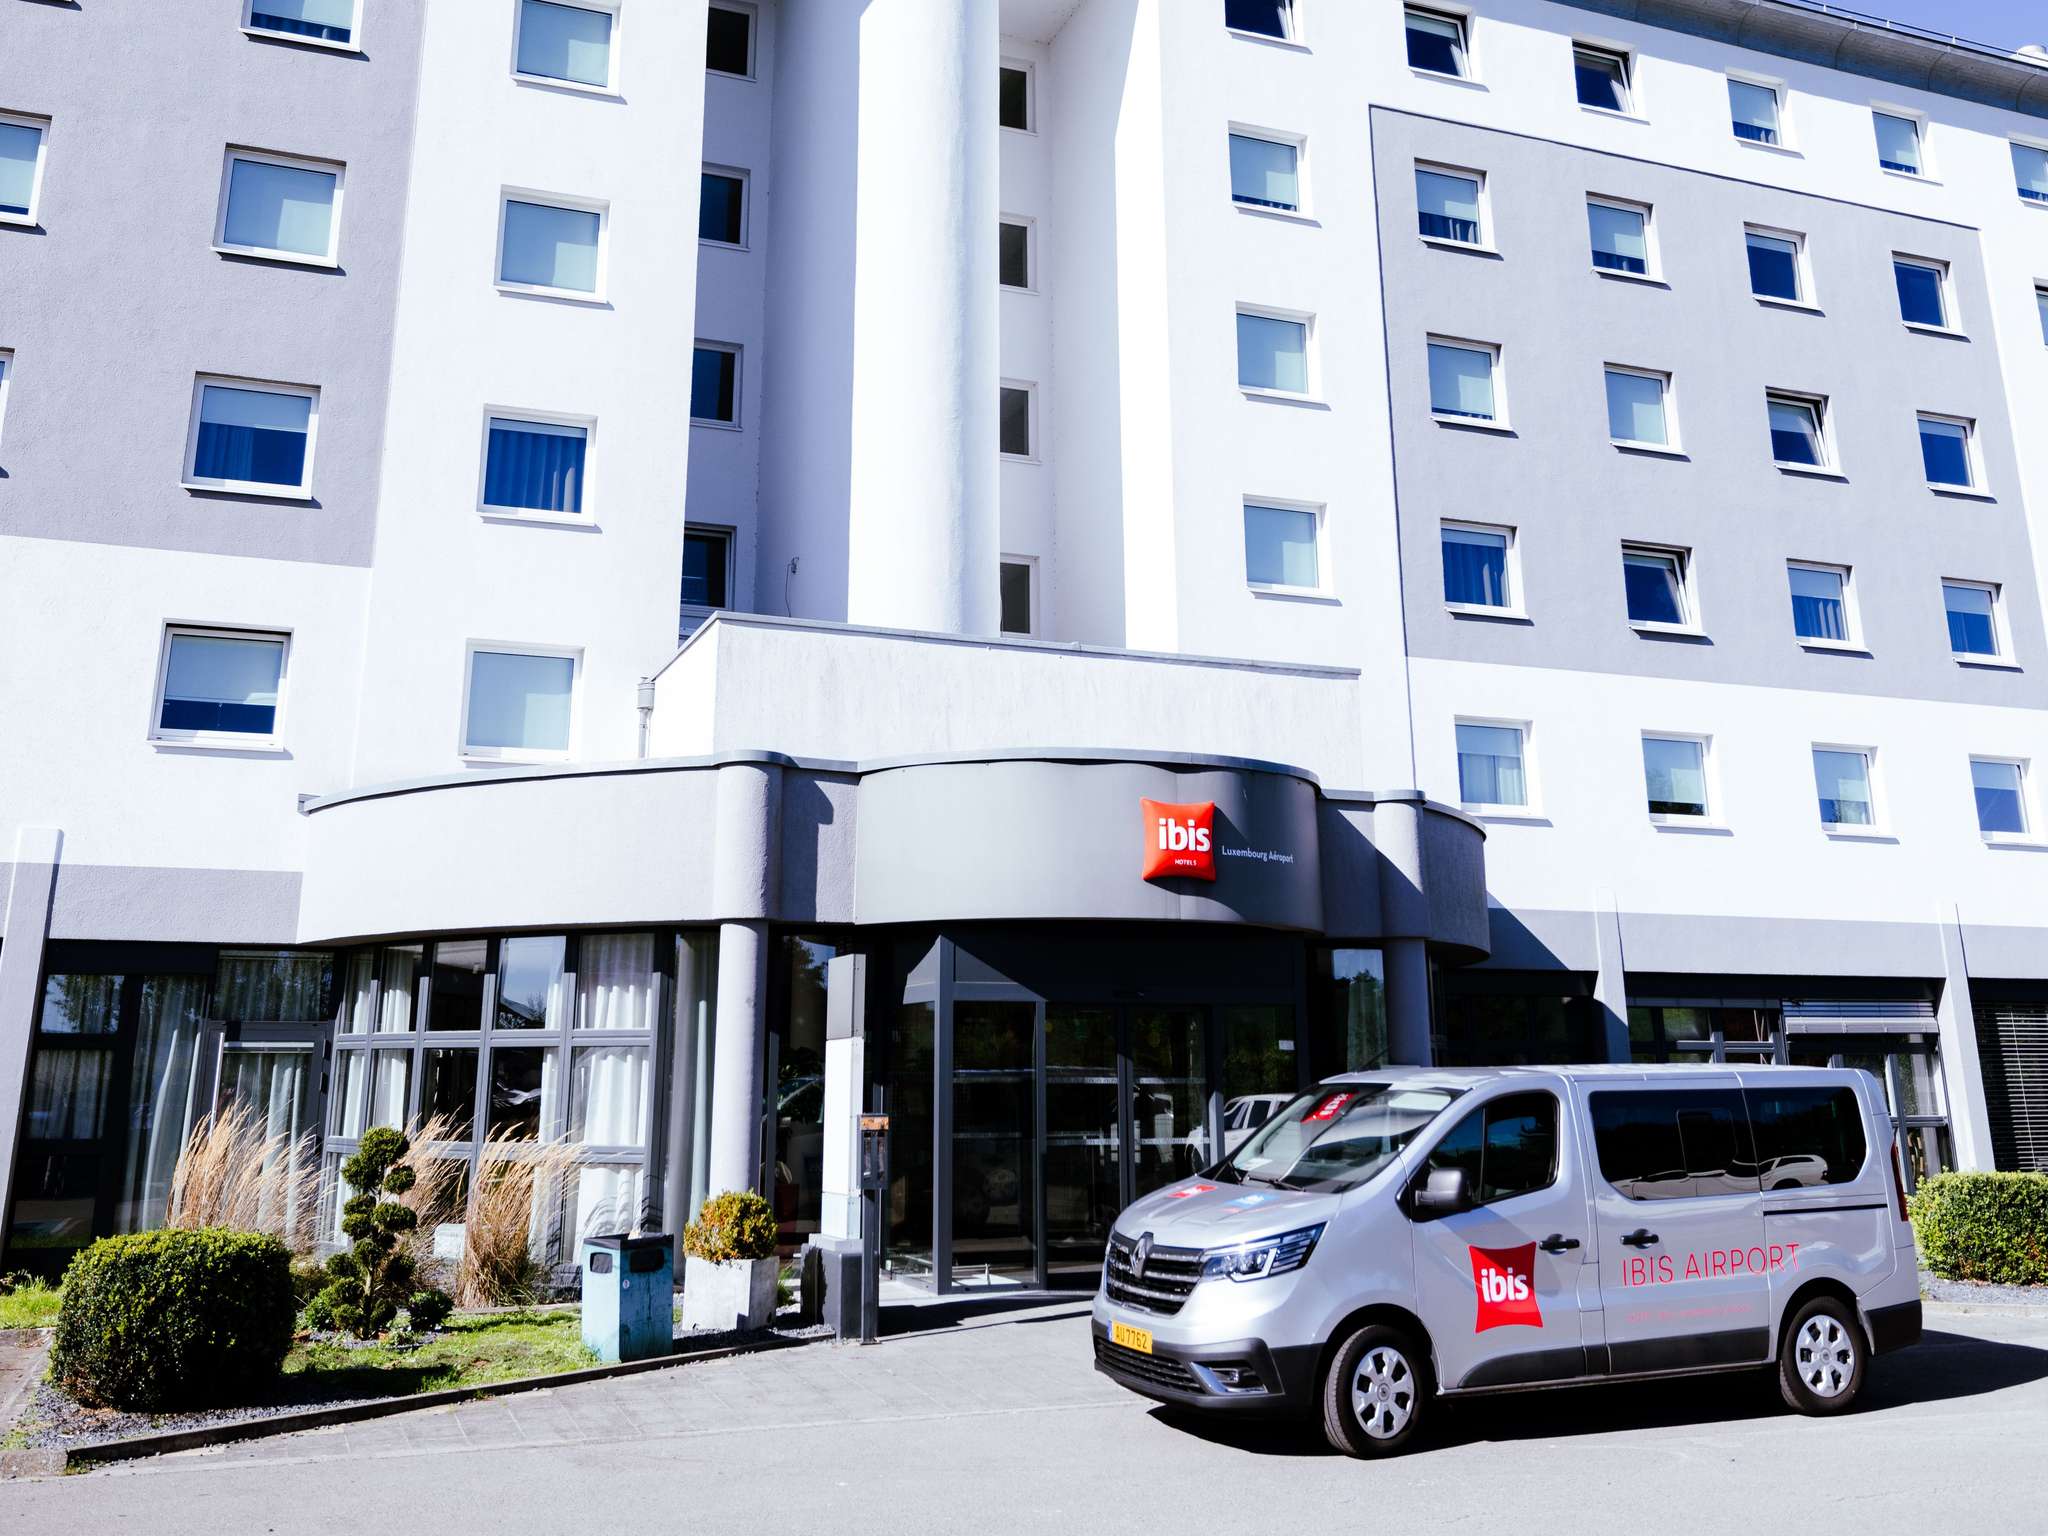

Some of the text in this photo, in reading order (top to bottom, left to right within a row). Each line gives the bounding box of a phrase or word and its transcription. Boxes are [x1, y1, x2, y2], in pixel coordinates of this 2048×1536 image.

[1158, 817, 1211, 852] ibis
[1221, 845, 1294, 865] Luxembourg Aéroport
[1622, 1242, 1801, 1287] IBIS AIRPORT
[1480, 1266, 1529, 1304] ibis
